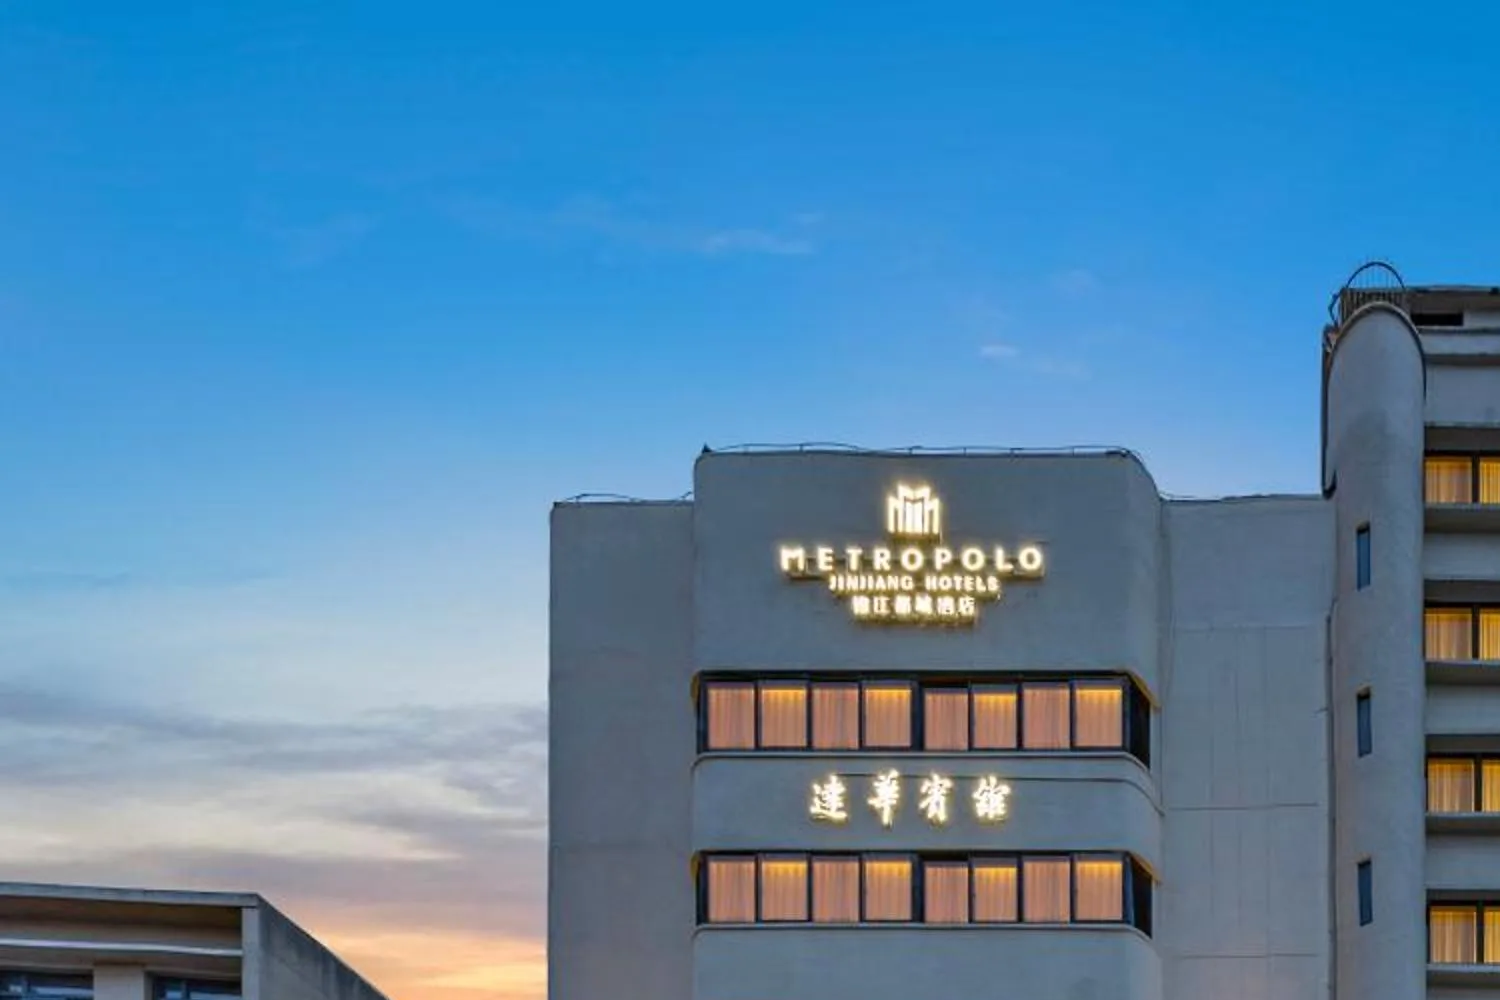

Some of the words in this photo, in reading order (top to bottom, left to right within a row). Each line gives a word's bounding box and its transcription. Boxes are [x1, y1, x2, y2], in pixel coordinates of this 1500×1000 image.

[780, 546, 1043, 572] METROPOLO
[829, 575, 913, 591] JINJIANG
[925, 575, 999, 592] HOTELS
